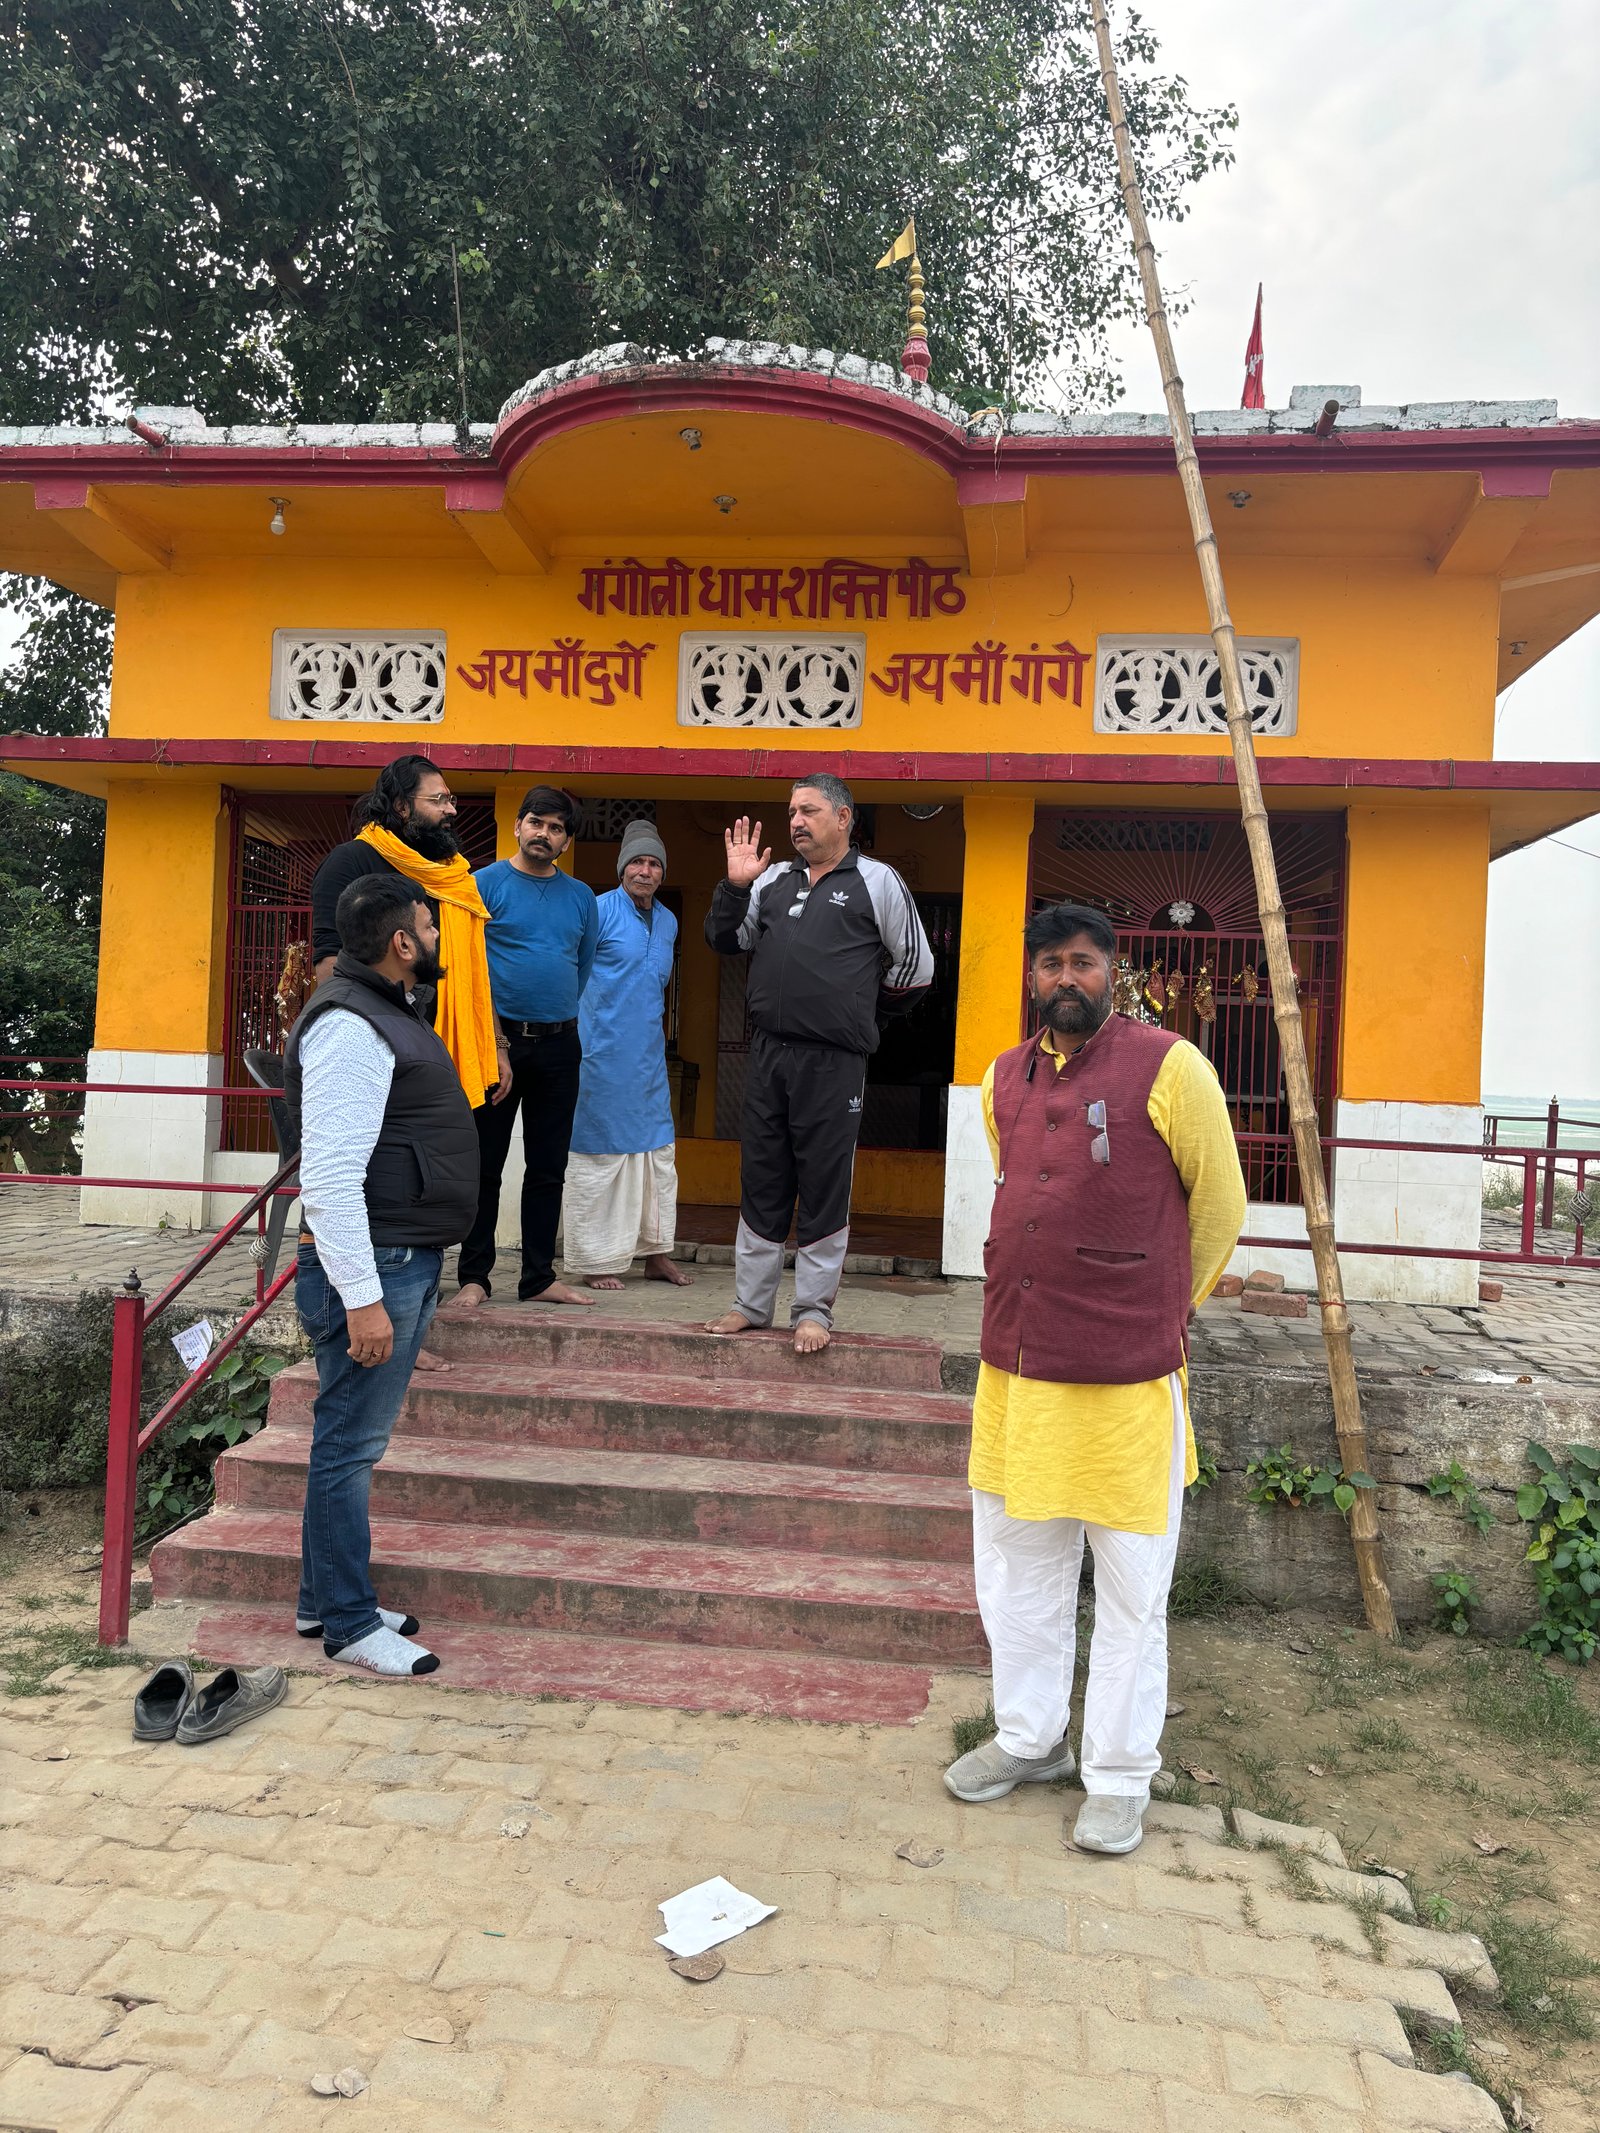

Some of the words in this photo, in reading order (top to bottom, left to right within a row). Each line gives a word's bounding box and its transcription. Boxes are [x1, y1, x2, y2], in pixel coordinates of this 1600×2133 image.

[577, 557, 695, 617] गंगोत्री
[456, 649, 535, 698] जय
[584, 639, 657, 705] दुर्गे
[869, 653, 950, 704] जय
[1010, 640, 1093, 707] गंगे
